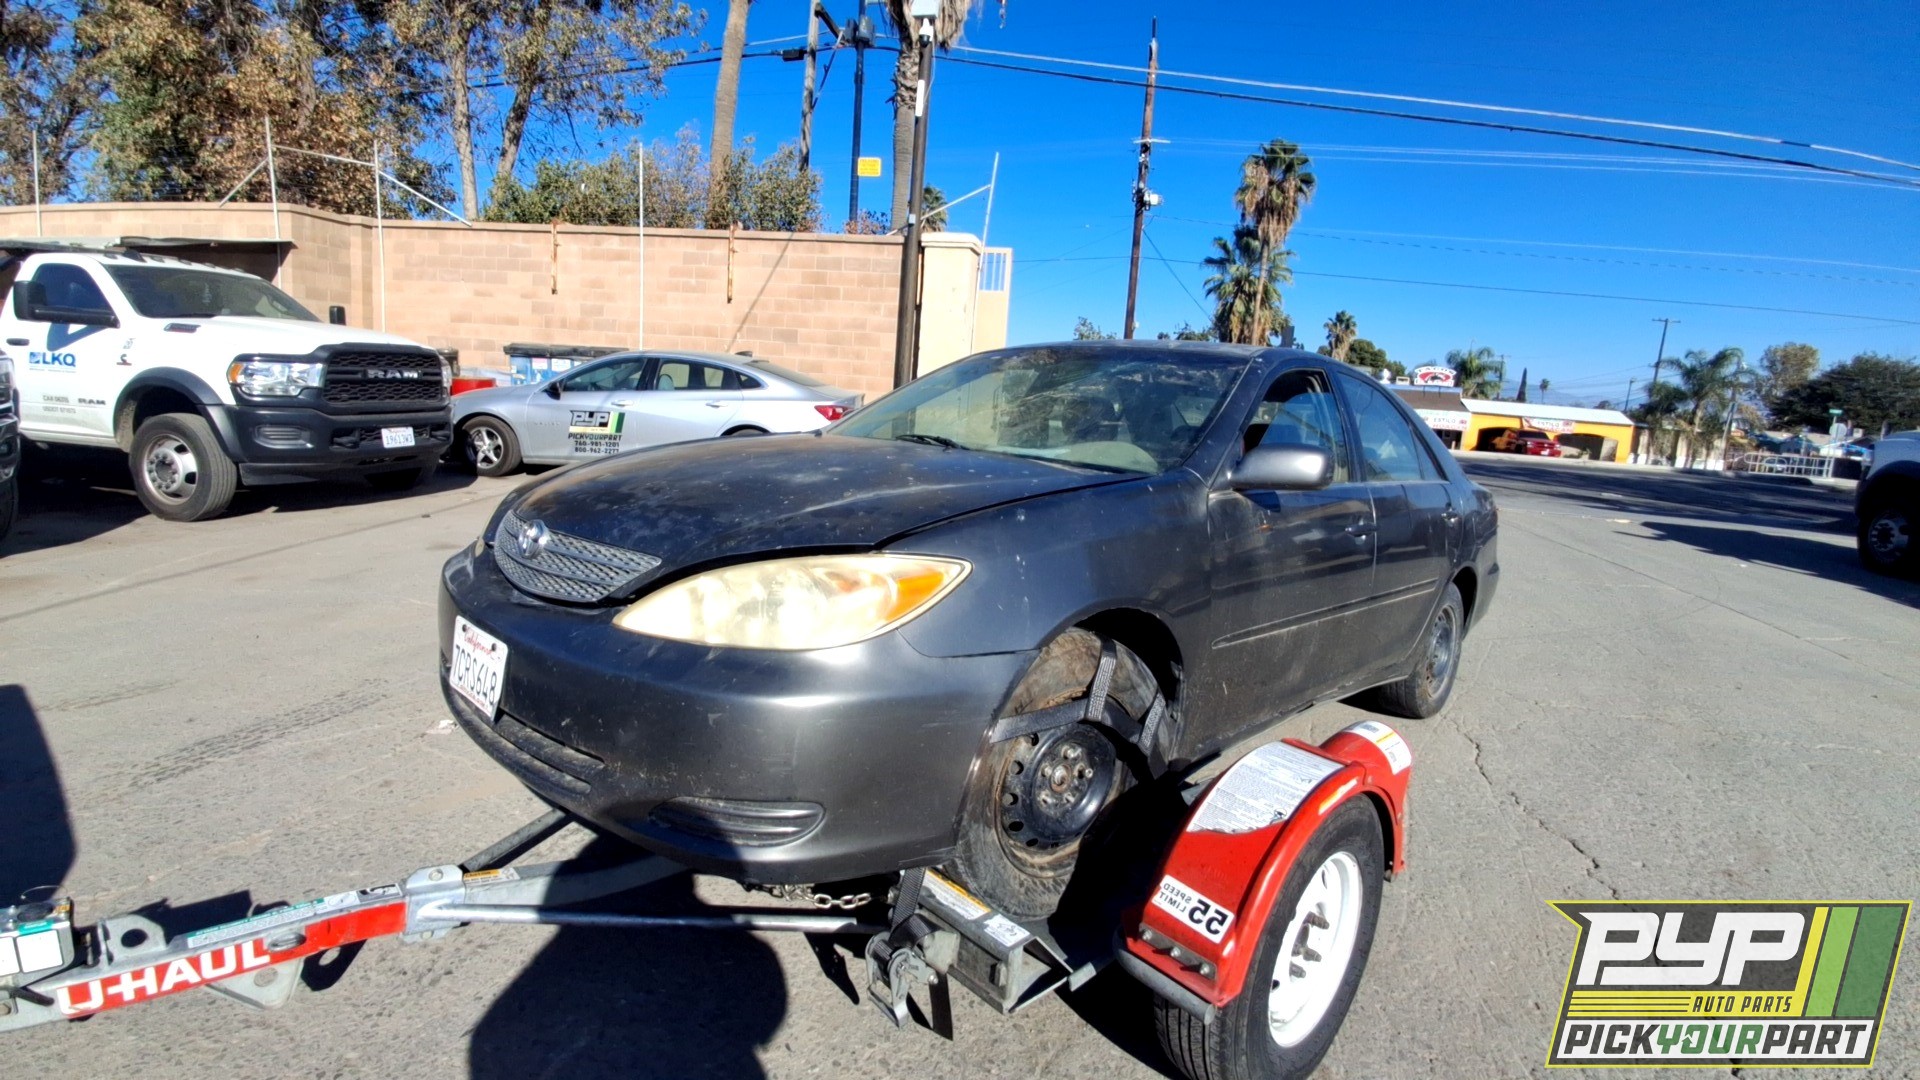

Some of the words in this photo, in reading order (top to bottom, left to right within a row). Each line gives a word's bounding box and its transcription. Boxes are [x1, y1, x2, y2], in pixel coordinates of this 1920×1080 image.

[42, 352, 76, 367] LKQ
[367, 369, 418, 379] RAM
[572, 411, 610, 427] PYP
[568, 432, 622, 442] PICKYOURPART
[453, 644, 497, 706] 7CRS648
